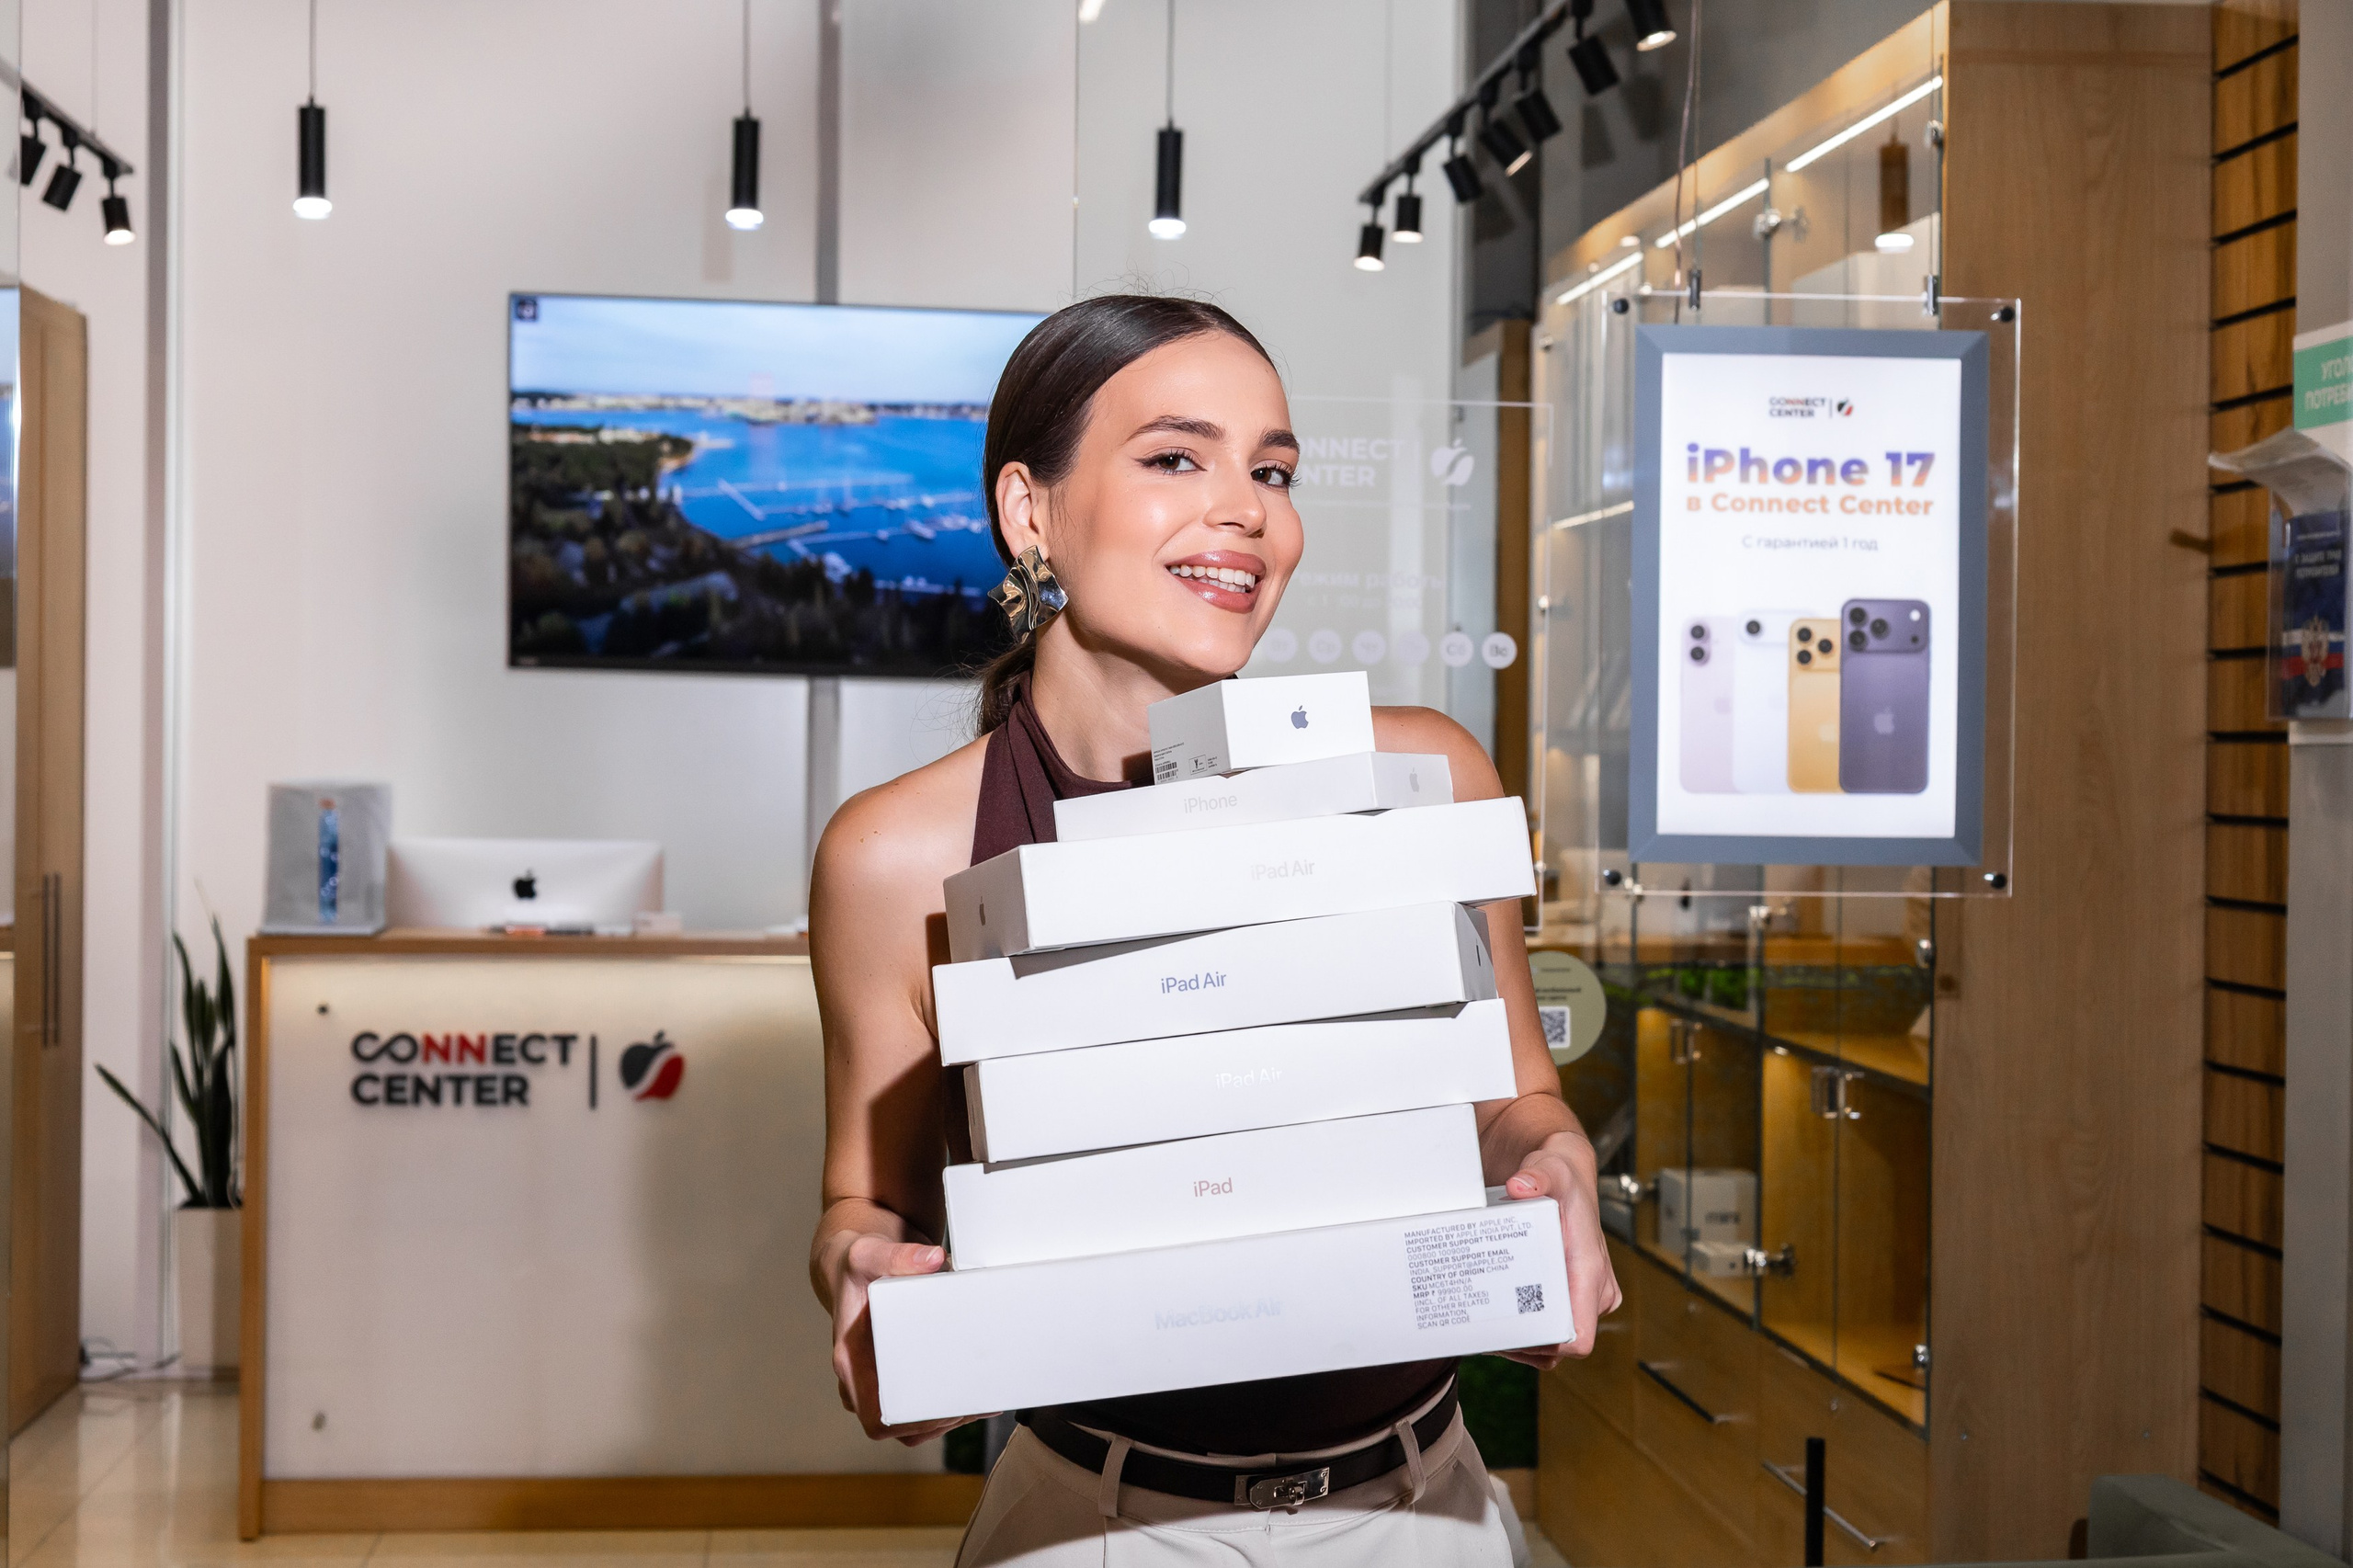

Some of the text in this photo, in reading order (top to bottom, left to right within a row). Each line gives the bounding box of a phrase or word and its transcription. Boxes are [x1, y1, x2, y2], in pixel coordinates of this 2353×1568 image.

[1768, 397, 1825, 408] CONNECT
[1768, 408, 1815, 418] CENTER
[1299, 437, 1405, 460] NNECT
[1687, 442, 1936, 487] iPhone 17
[1302, 464, 1376, 487] NTER
[1711, 493, 1829, 515] Connect
[1839, 494, 1934, 516] Center
[1757, 535, 1838, 551] гарантией
[1842, 537, 1849, 550] 1
[1853, 540, 1879, 551] год
[1294, 571, 1359, 587] ежим
[1183, 793, 1238, 814] iPhone
[1250, 858, 1315, 881] iPad Air
[1161, 971, 1227, 994] iPad Air
[350, 1030, 578, 1066] CONNECT
[1215, 1066, 1283, 1090] iPad Air
[350, 1072, 530, 1108] CENTER
[1193, 1176, 1233, 1198] iPad
[1404, 1223, 1466, 1238] MANUFACTURED
[1467, 1221, 1477, 1230] BY
[1480, 1218, 1502, 1228] APPLE
[1405, 1234, 1444, 1246] IMPORTED
[1445, 1233, 1455, 1241] BY
[1456, 1229, 1478, 1238] APPLE
[1480, 1226, 1499, 1235] INDIA
[1406, 1230, 1529, 1255] CUSTOMER SUPPORT TELEPHONE
[1438, 1246, 1471, 1256] 1009009
[1409, 1248, 1510, 1269] CUSTOMER SUPPORT EMAIL
[1411, 1264, 1509, 1284] COUNTRY OF ORIGIN CHINA
[1412, 1283, 1427, 1292] SKU
[1414, 1290, 1430, 1299] MRP
[1438, 1285, 1473, 1296] 99900.00
[1449, 1293, 1461, 1302] ALL
[1463, 1290, 1489, 1300] TAXES)
[1154, 1295, 1283, 1331] MacBook Air
[1415, 1297, 1491, 1314] FOR OTHER RELATED
[1417, 1315, 1471, 1330] SCAN QR CODE
